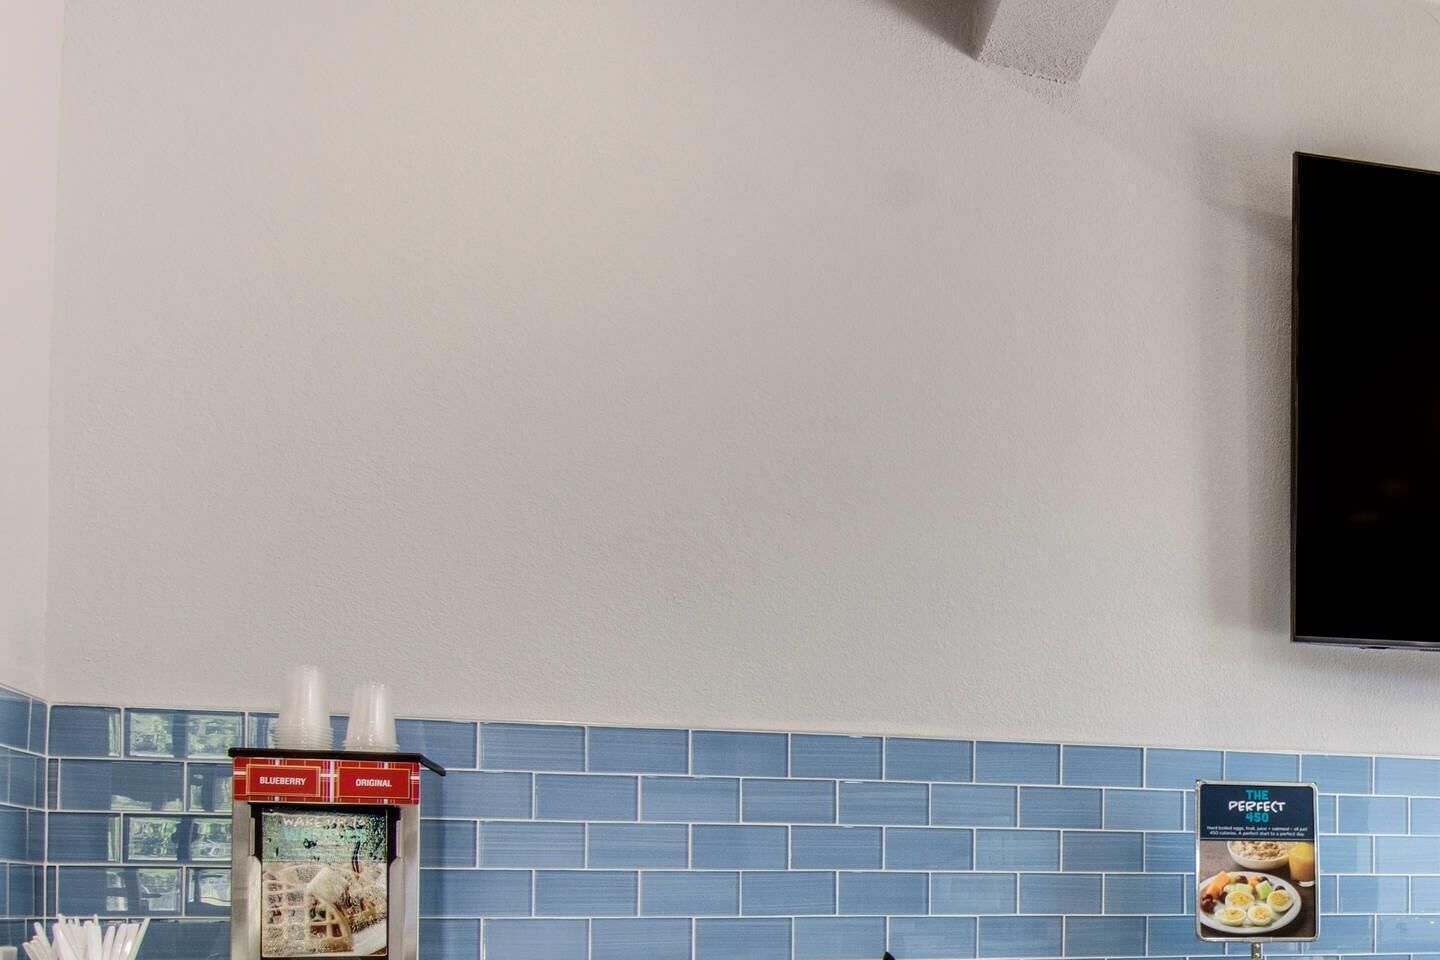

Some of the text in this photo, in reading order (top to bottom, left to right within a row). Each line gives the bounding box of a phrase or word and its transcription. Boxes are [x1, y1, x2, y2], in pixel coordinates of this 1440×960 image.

[259, 776, 307, 786] BLUEBERRY
[355, 778, 393, 788] ORIGINAL
[1246, 789, 1269, 800] THE
[1228, 800, 1286, 813] PERFECT
[1245, 812, 1269, 823] 450
